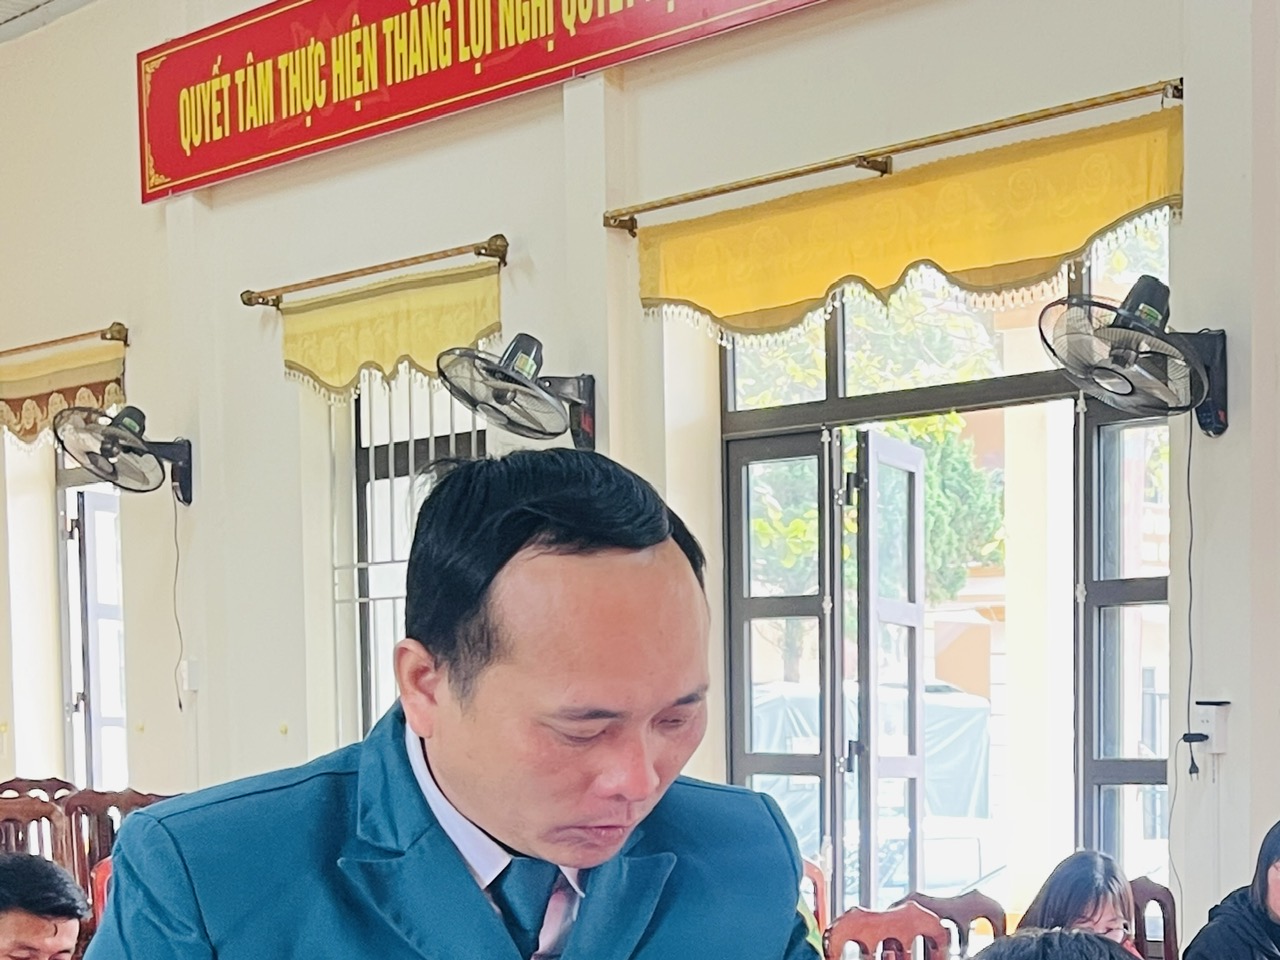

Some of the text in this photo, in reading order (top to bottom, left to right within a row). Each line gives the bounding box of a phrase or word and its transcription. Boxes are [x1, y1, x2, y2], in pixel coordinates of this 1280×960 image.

[178, 55, 230, 156] QUYẾT
[235, 51, 275, 133] TÂM
[277, 36, 326, 127] THỰC
[331, 13, 378, 112] HIỆN
